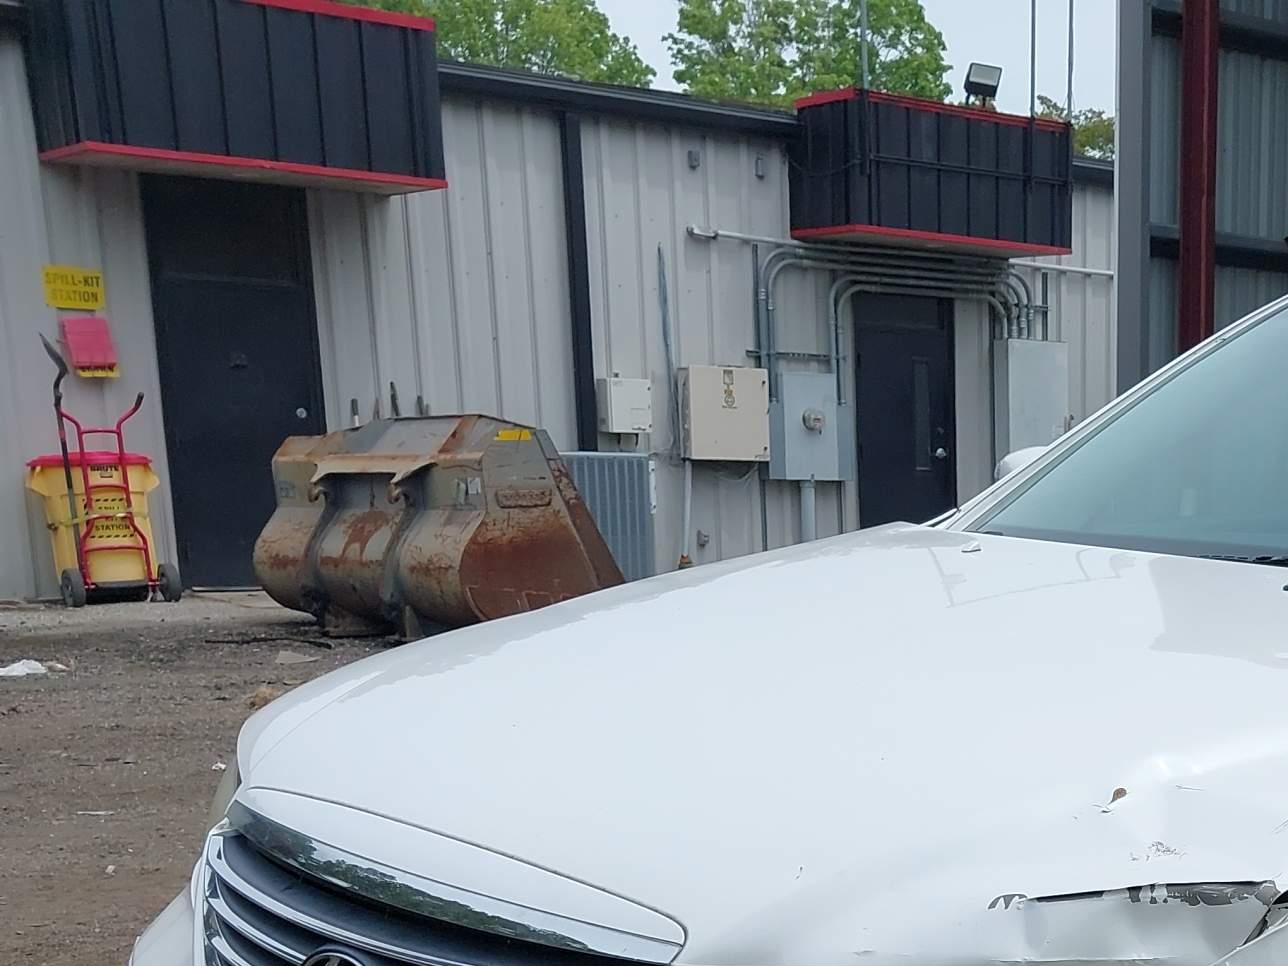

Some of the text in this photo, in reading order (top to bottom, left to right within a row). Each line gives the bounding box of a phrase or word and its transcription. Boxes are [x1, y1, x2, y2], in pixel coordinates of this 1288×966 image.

[45, 271, 101, 288] SPILL-KIT
[51, 288, 99, 303] STATION
[95, 523, 130, 531] STATION
